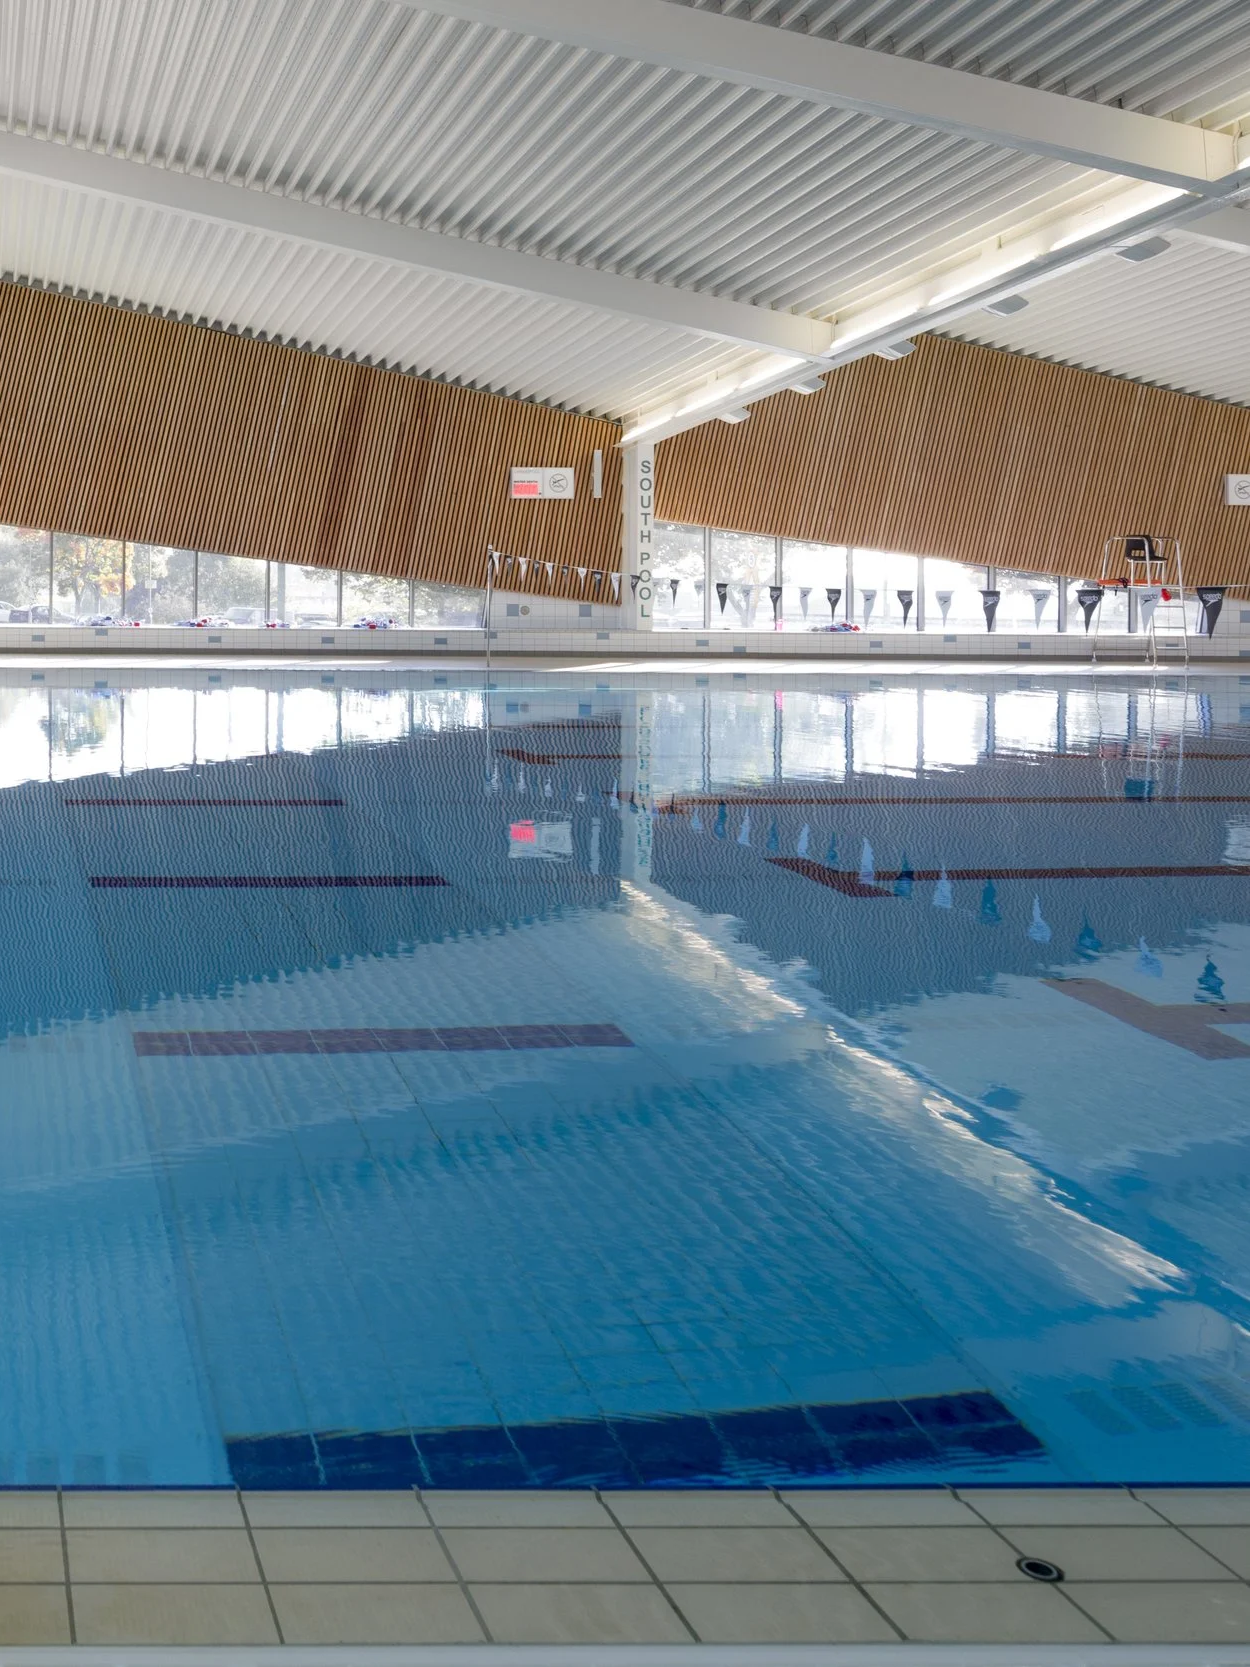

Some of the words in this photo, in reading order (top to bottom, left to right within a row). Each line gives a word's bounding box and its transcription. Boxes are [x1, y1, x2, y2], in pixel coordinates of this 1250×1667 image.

[640, 460, 652, 543] SOUTH
[639, 552, 652, 618] POOL
[1202, 592, 1222, 600] speedo
